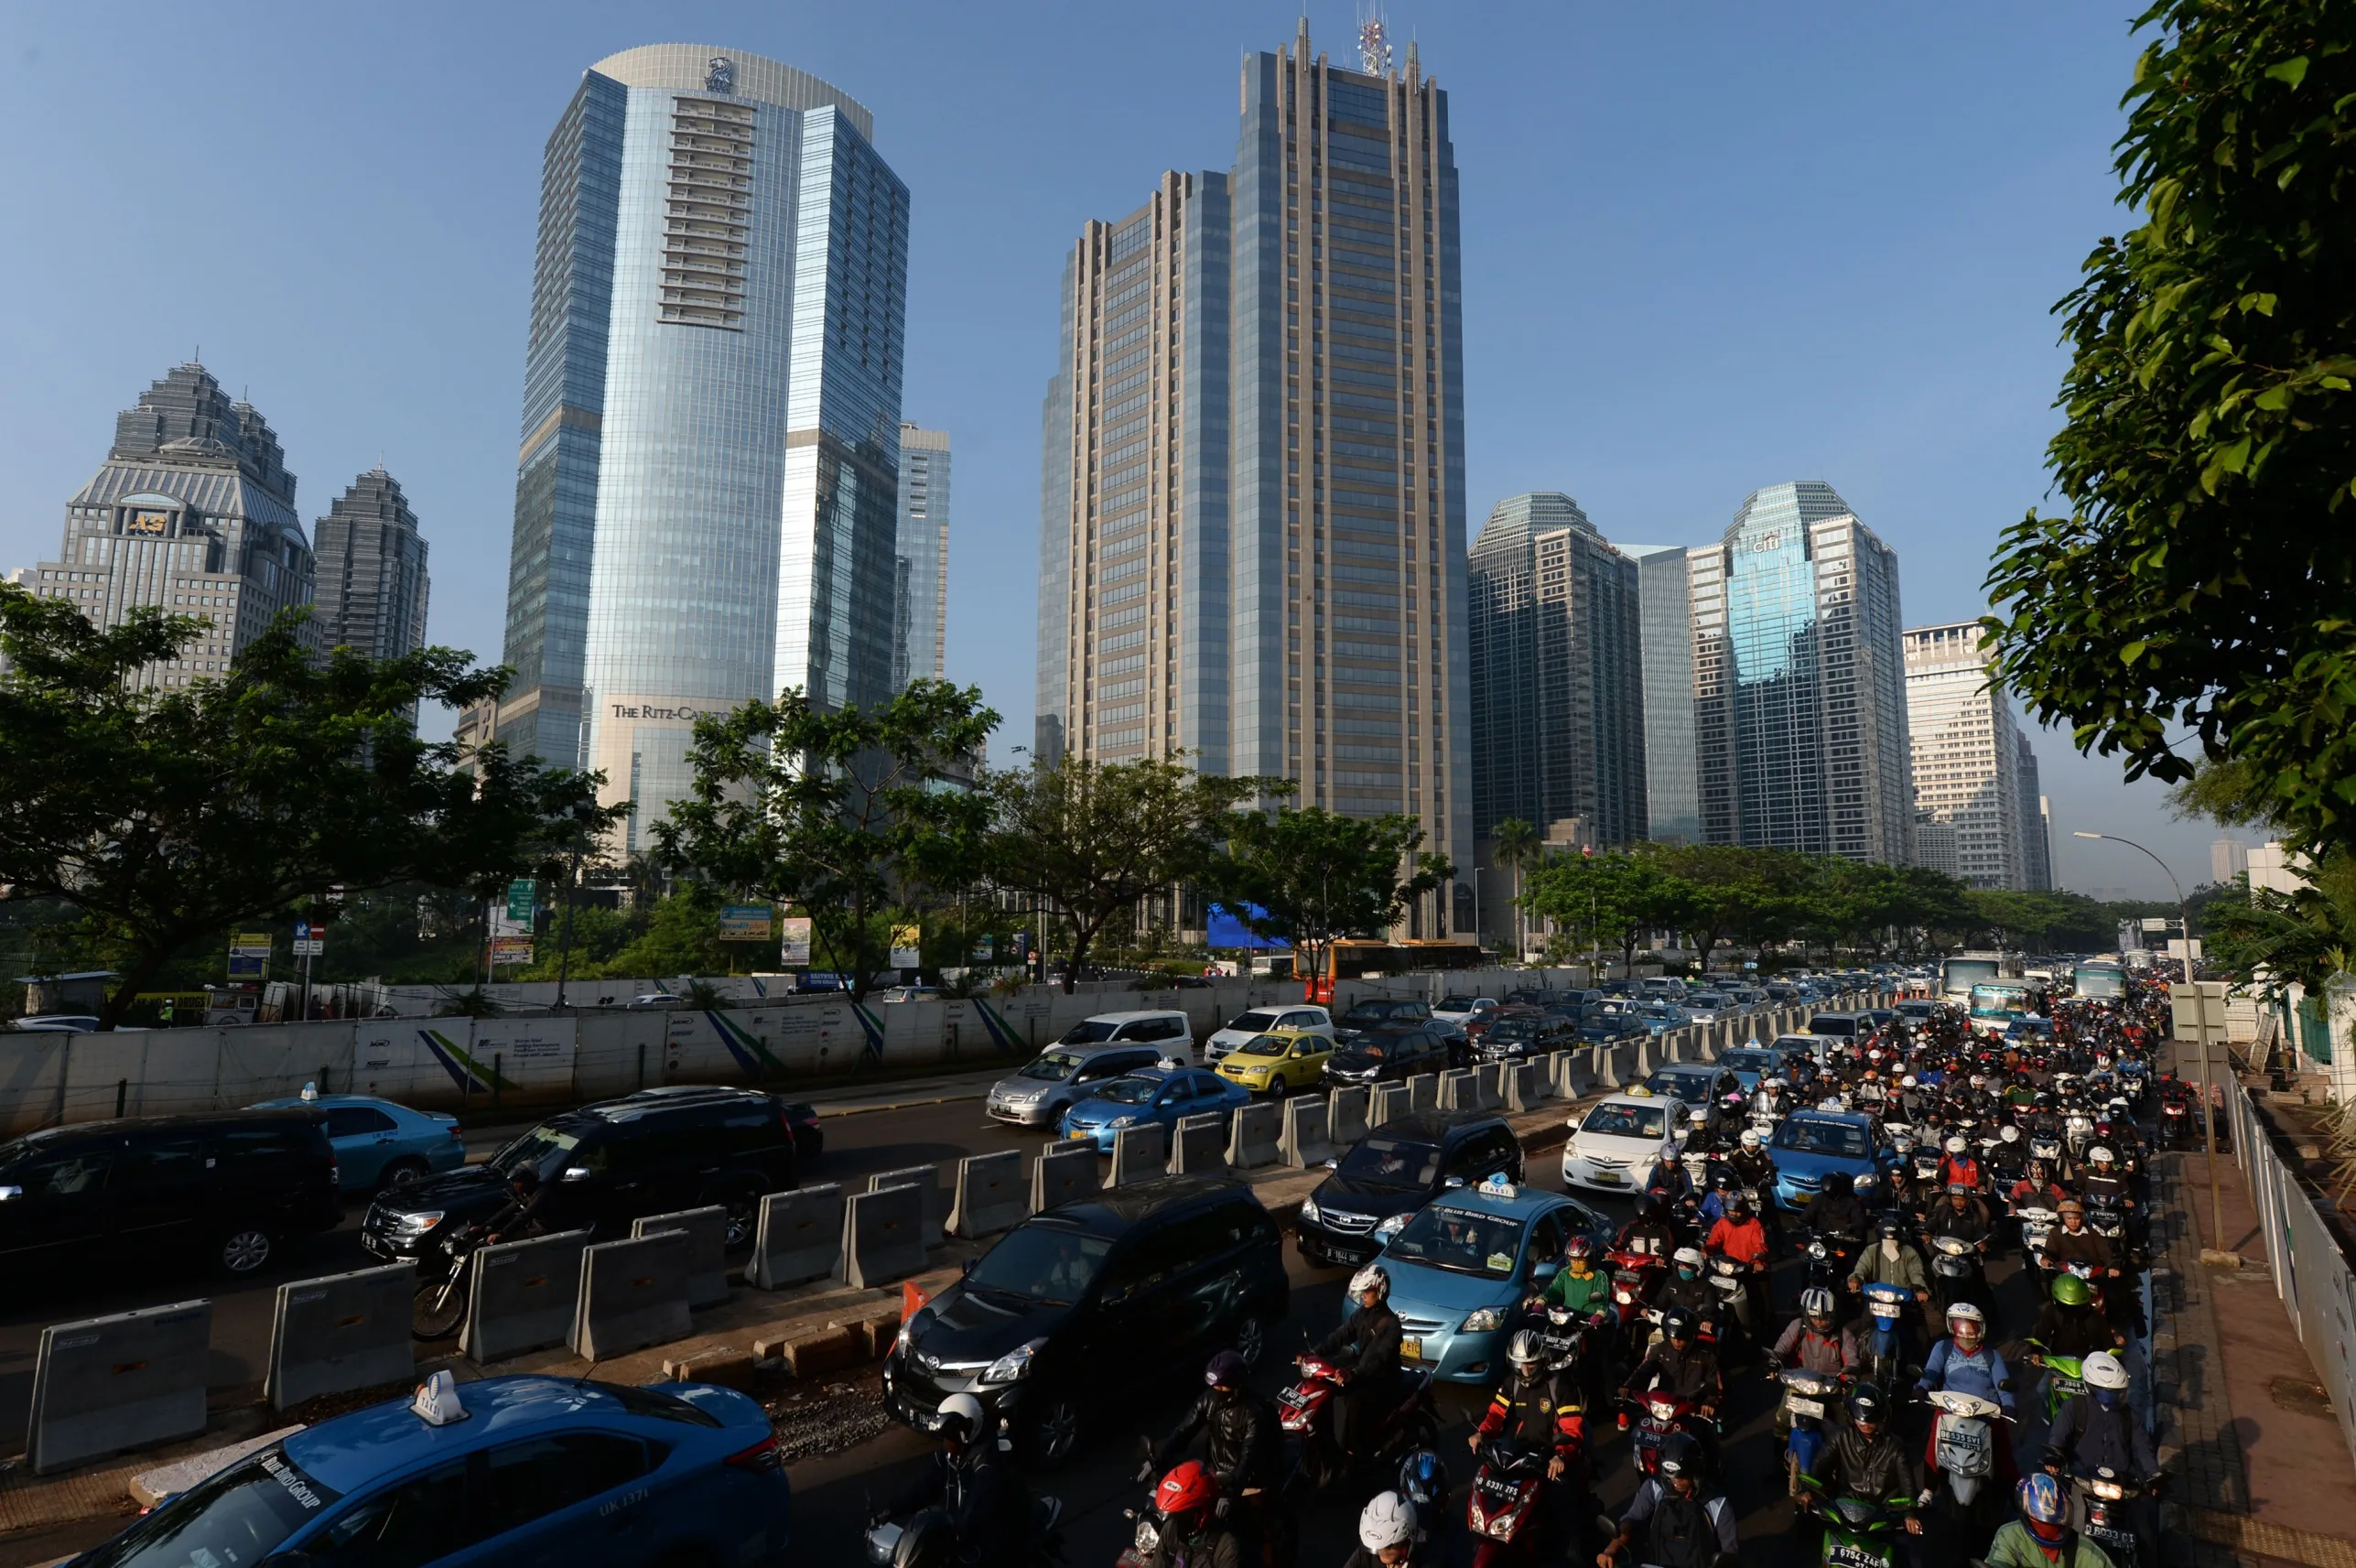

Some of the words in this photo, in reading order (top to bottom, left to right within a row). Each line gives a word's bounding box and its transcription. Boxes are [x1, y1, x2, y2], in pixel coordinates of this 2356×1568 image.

[1754, 533, 1779, 553] citi
[611, 704, 639, 719] THE
[1485, 1185, 1508, 1195] TAKSI
[1465, 1210, 1486, 1219] BIRD
[1486, 1214, 1518, 1227] GROUP
[420, 1397, 439, 1417] TAKSI
[260, 1455, 280, 1477] BLUE
[275, 1466, 297, 1488] BIRD
[287, 1479, 320, 1509] GROUP
[1486, 1479, 1503, 1491] 6331
[1505, 1484, 1518, 1497] ZFS
[599, 1499, 621, 1517] UK
[623, 1487, 650, 1507] 1371
[1840, 1547, 1862, 1560] 6754
